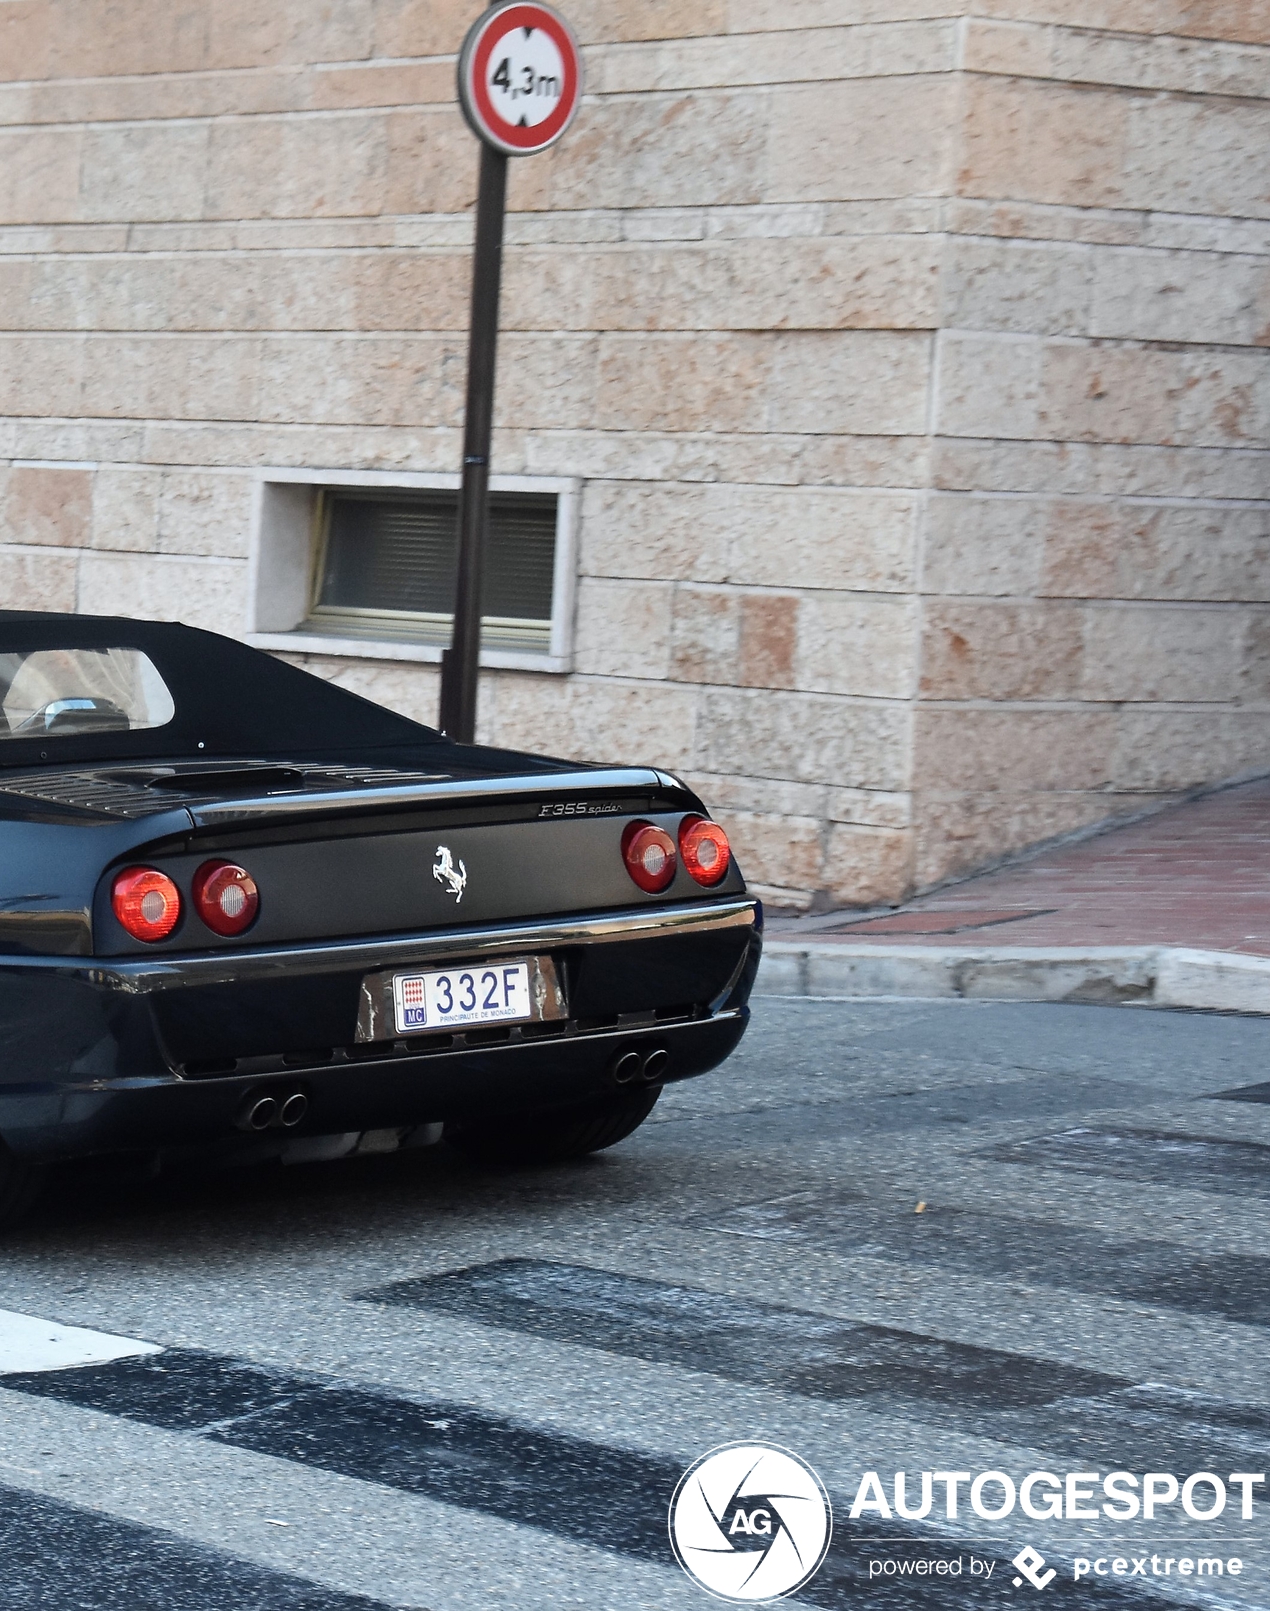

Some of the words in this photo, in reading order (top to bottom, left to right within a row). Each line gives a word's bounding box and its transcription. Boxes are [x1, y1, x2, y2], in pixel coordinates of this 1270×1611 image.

[538, 802, 587, 816] F355
[587, 803, 622, 815] spider
[436, 968, 519, 1013] 332F
[408, 1009, 422, 1022] MC
